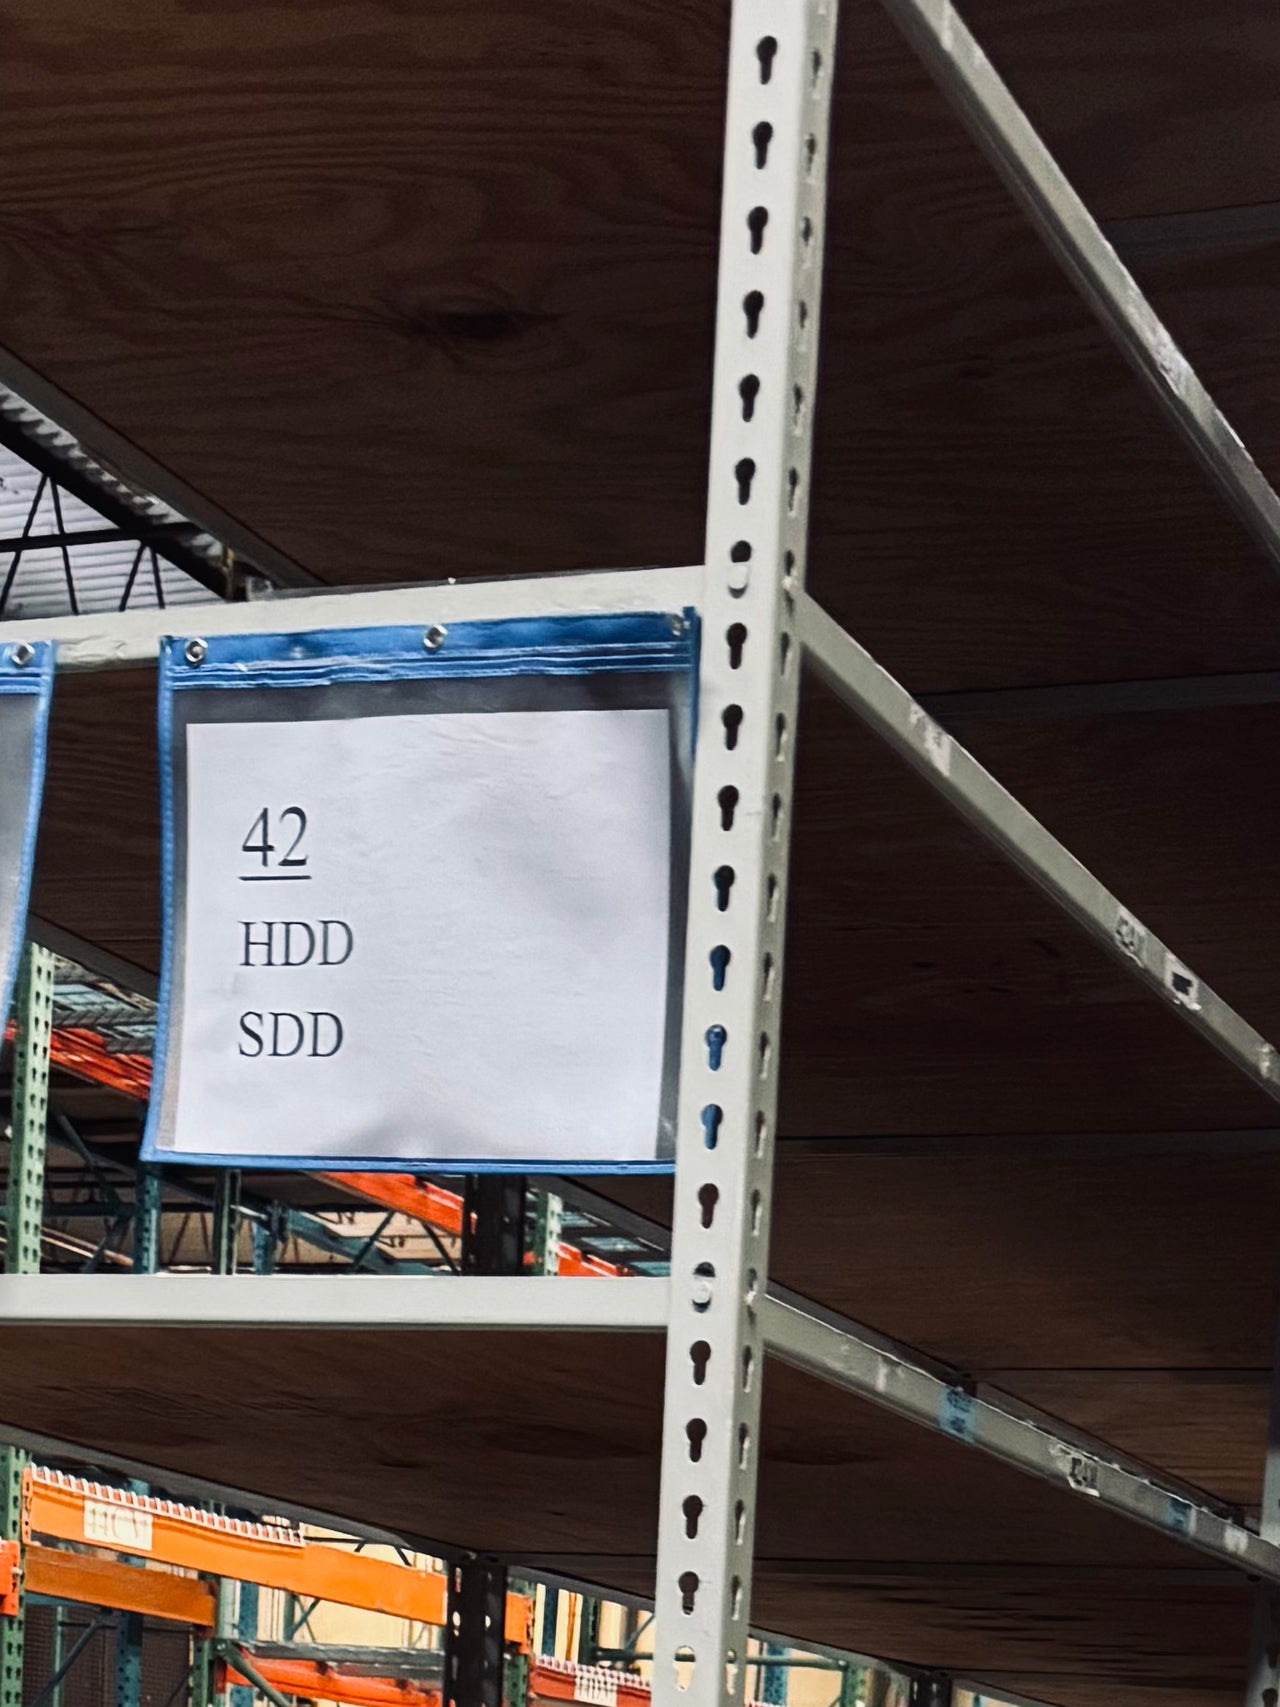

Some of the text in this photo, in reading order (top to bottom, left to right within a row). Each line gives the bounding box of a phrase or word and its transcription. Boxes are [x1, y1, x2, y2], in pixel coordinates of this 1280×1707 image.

[241, 806, 308, 867] 42
[238, 920, 353, 966] HDD
[238, 1011, 344, 1057] SDD
